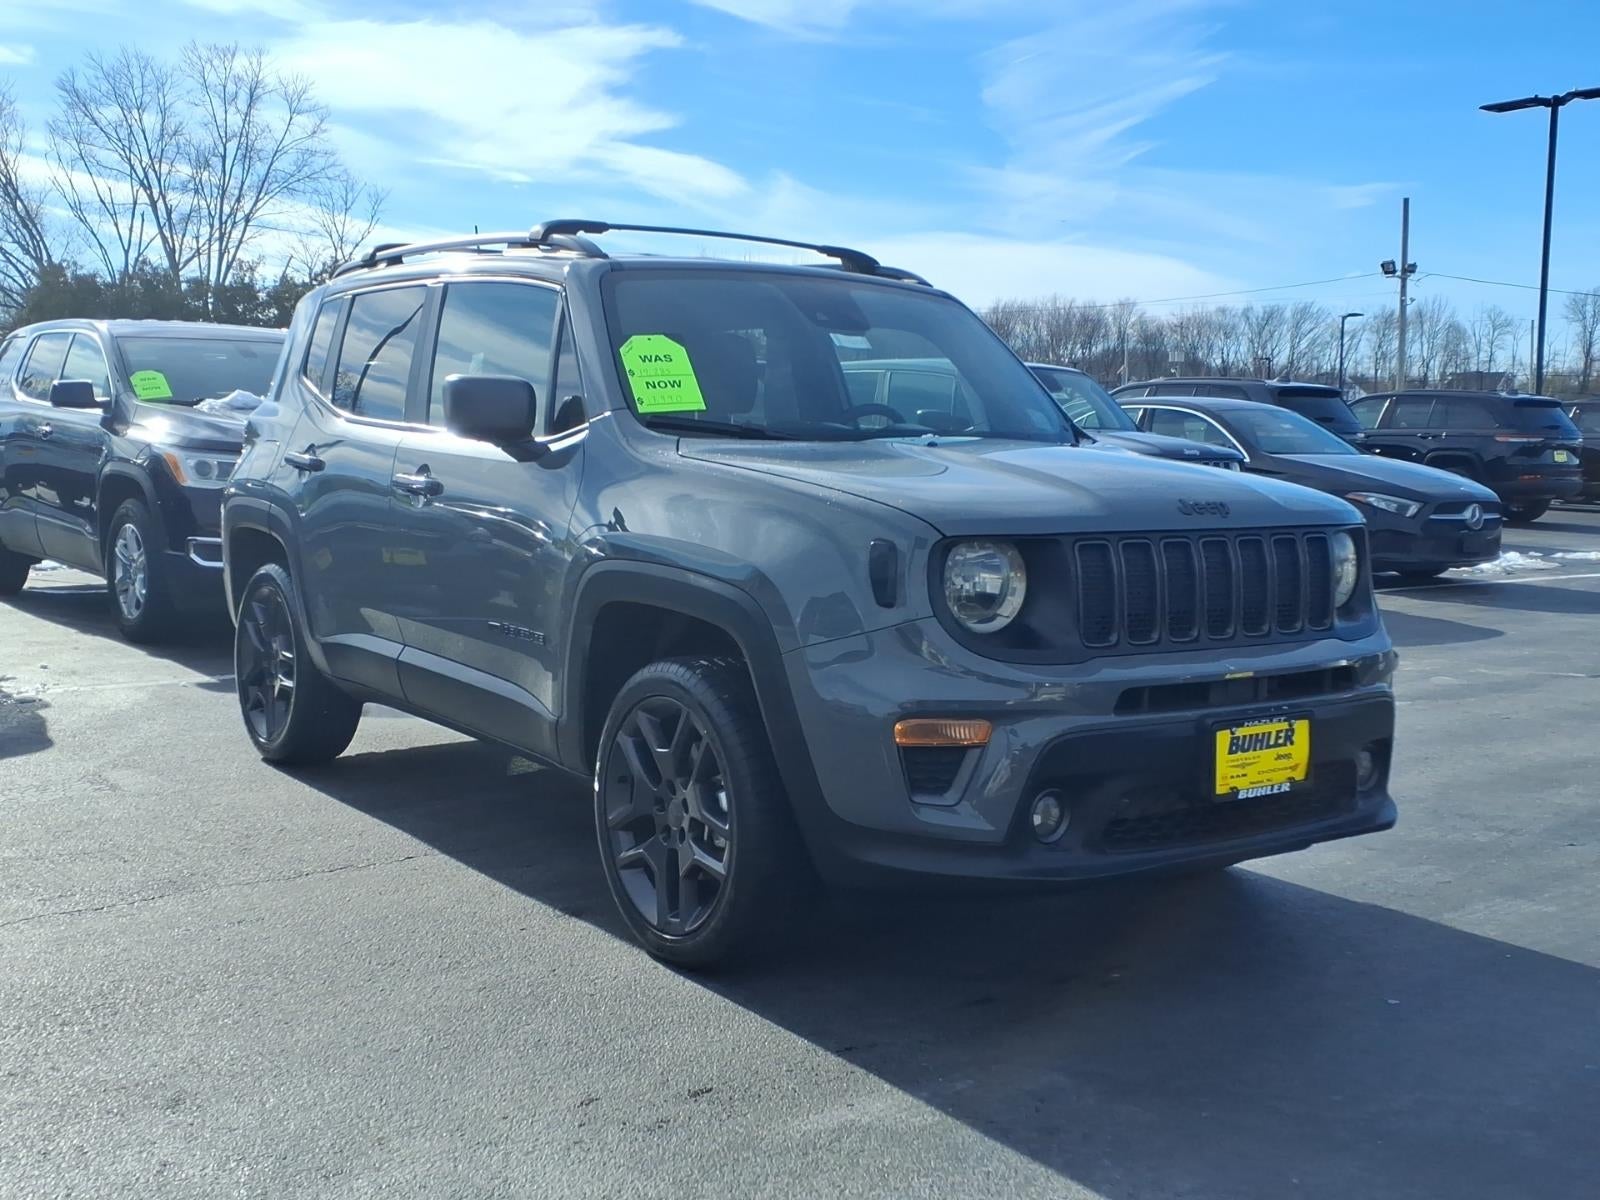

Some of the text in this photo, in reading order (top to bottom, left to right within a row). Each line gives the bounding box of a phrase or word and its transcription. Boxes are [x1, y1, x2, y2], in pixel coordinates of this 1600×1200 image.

[639, 354, 673, 363] WAS
[645, 379, 682, 390] NOW
[1177, 498, 1230, 519] Jeep
[1228, 728, 1295, 755] BUHLER
[1238, 782, 1291, 799] BUHLER
